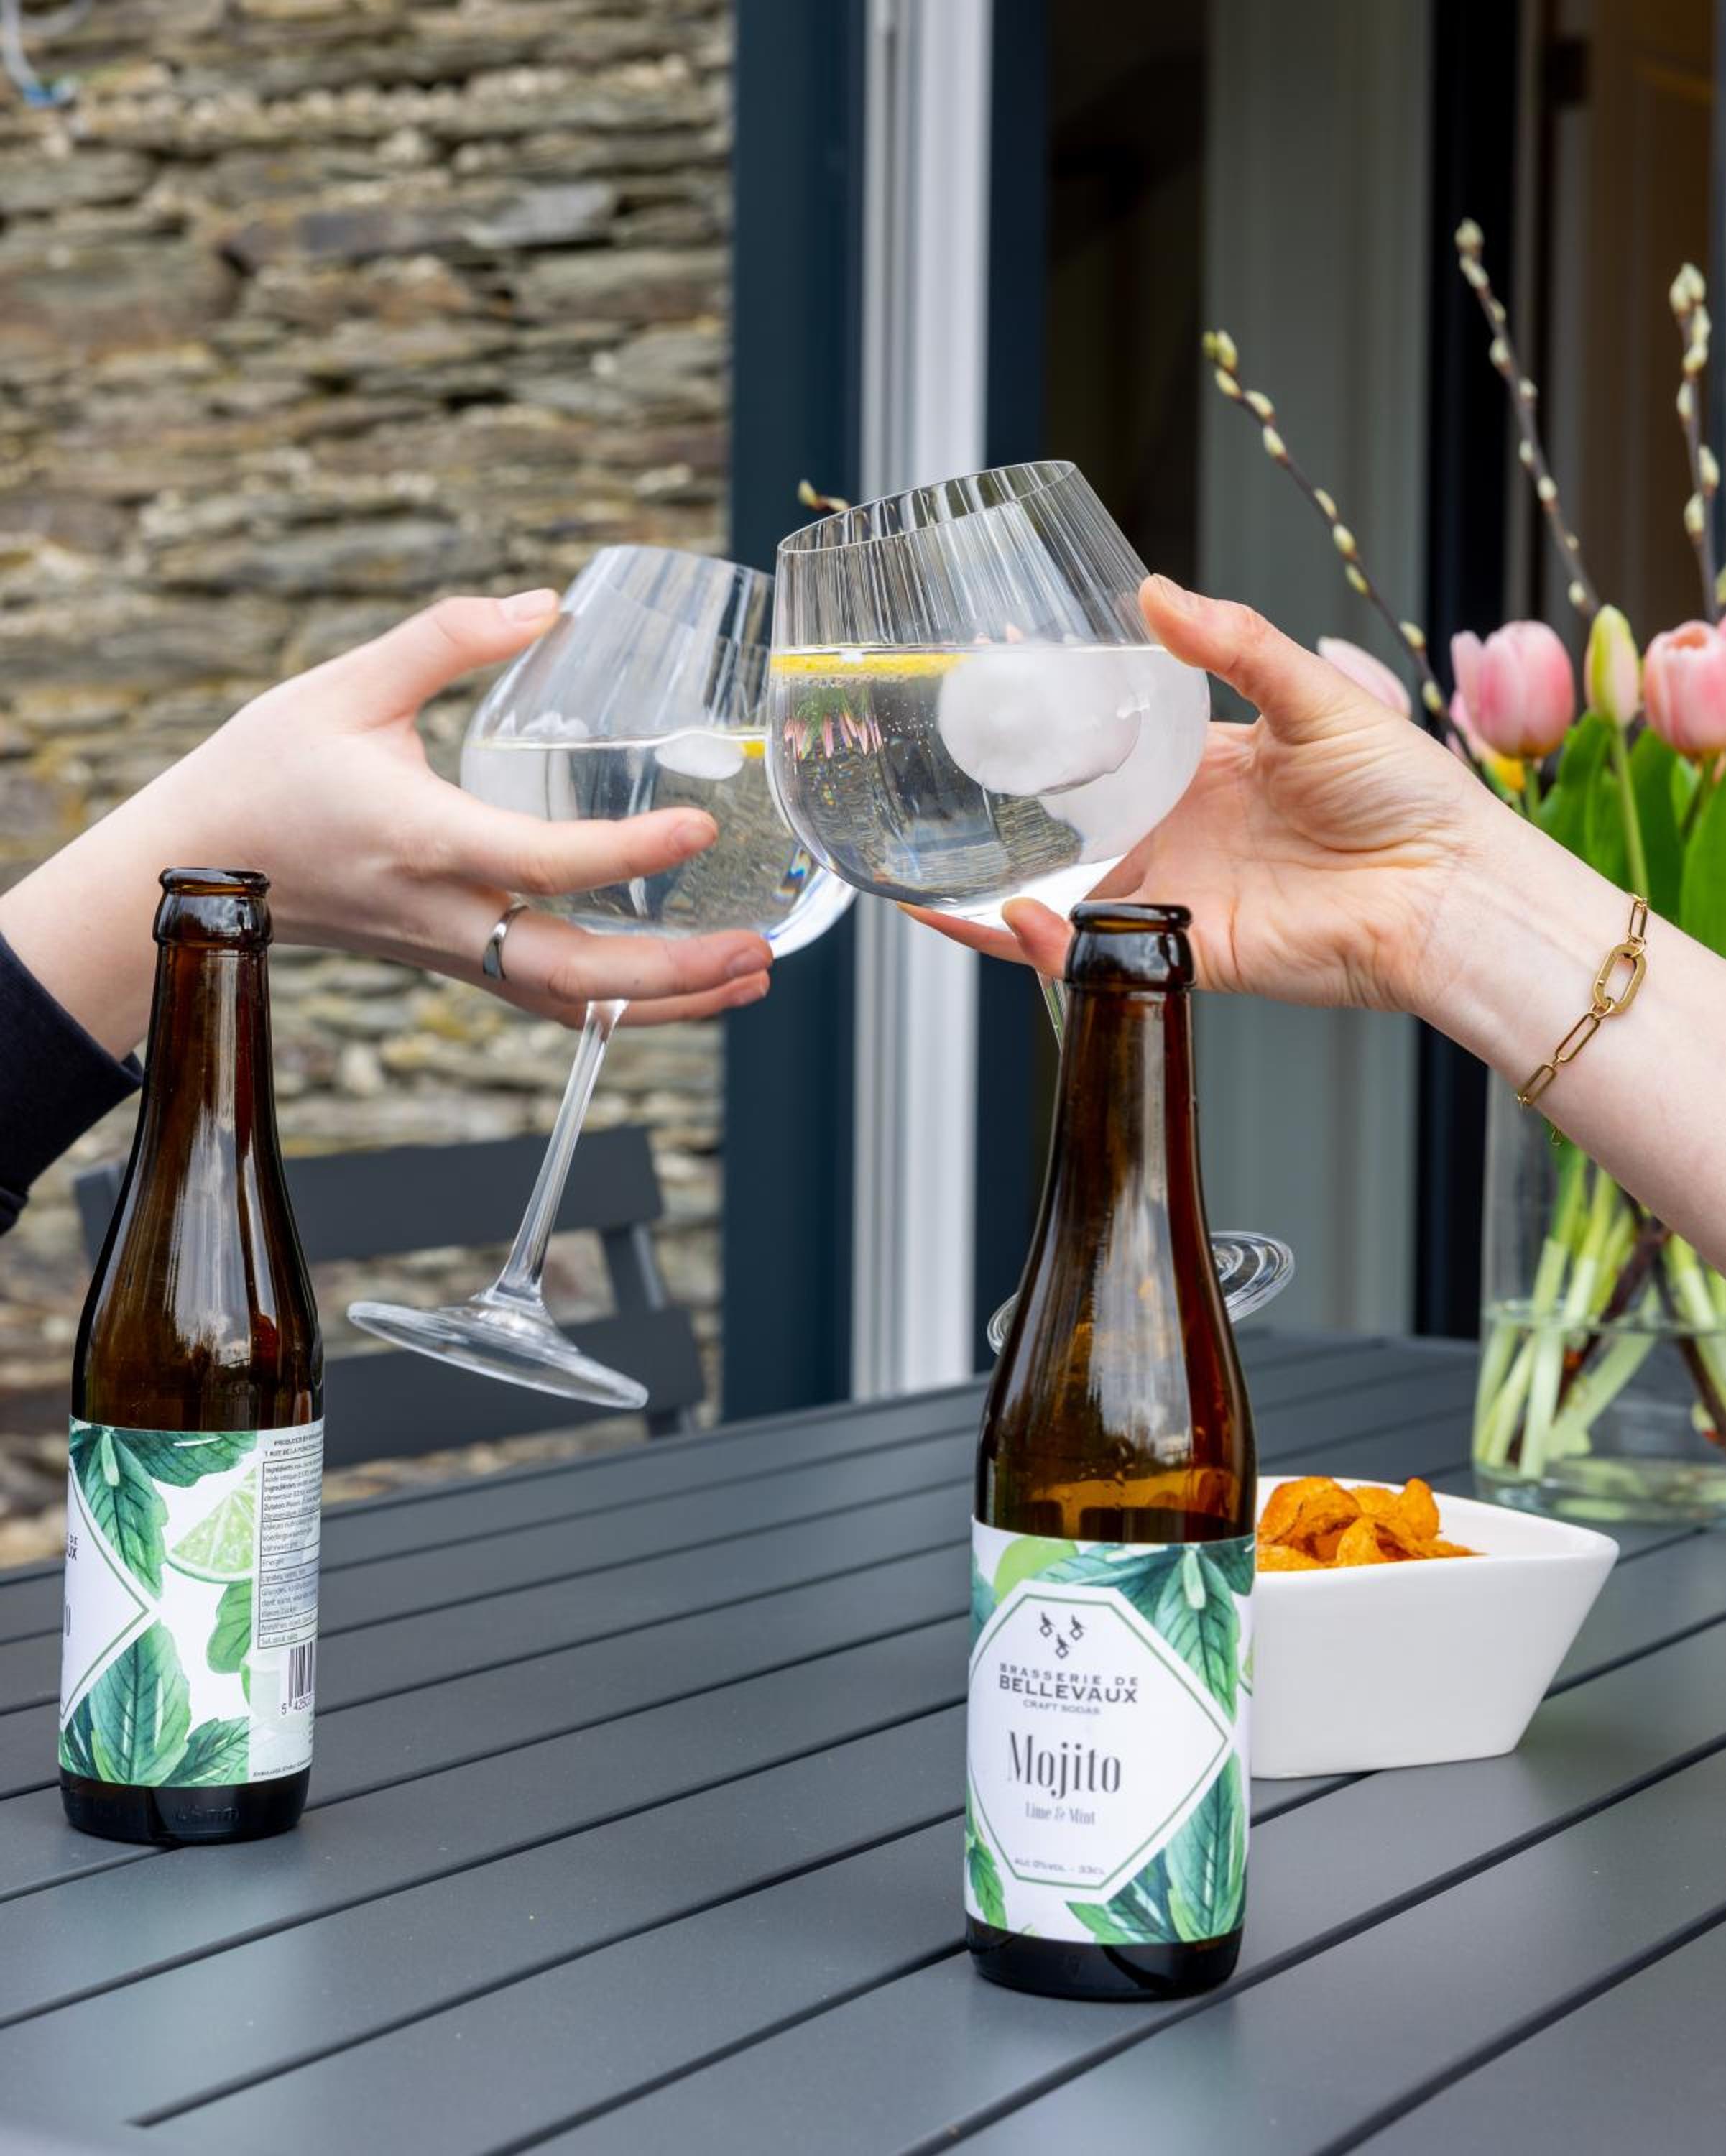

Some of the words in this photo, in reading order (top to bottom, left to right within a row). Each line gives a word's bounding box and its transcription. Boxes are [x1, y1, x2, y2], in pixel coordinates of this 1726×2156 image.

[1000, 1662, 1102, 1685] BRASSERIE
[1115, 1676, 1138, 1687] DE
[1000, 1674, 1137, 1703] BELLEVAUX
[281, 1702, 287, 1715] 5
[1023, 1699, 1058, 1712] CRAFT
[1061, 1703, 1100, 1715] SODAS
[1007, 1731, 1121, 1800] Mojito
[1025, 1802, 1051, 1820] Lime
[1069, 1808, 1096, 1825] Mint
